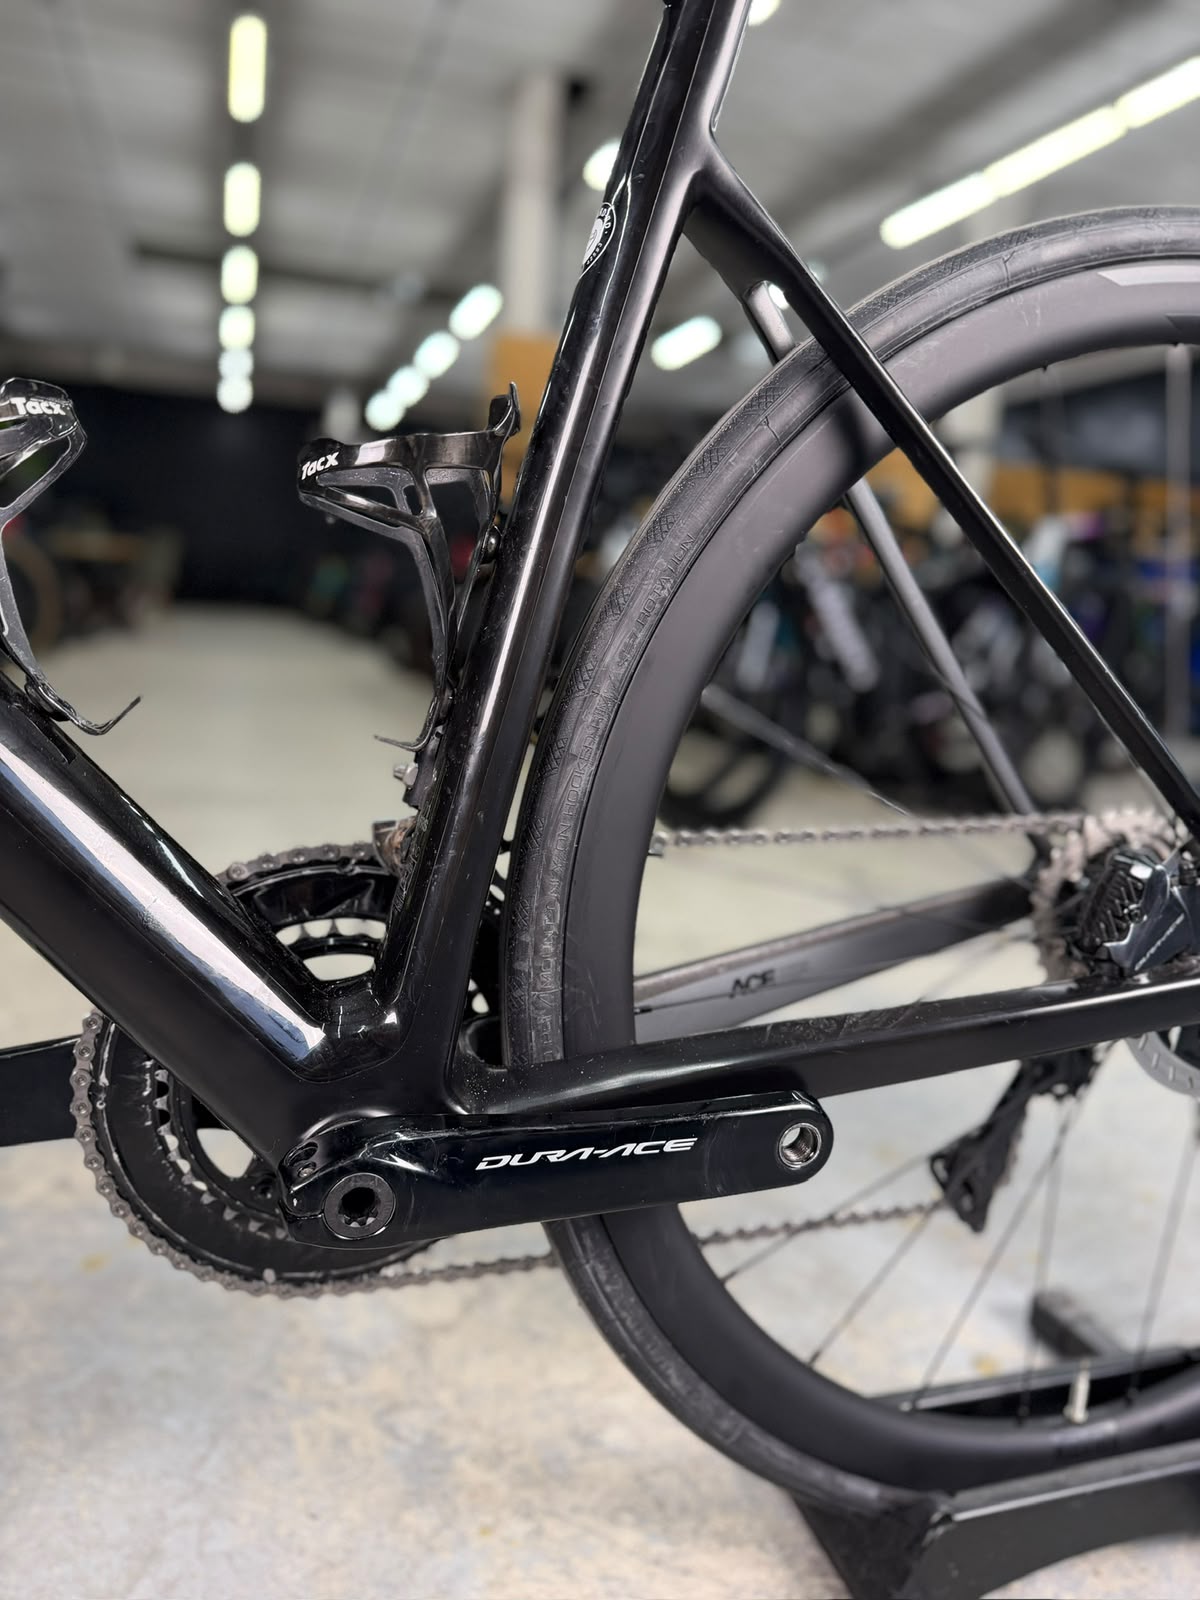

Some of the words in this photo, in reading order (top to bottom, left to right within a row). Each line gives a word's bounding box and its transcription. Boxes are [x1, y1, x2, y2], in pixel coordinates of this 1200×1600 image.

[9, 396, 66, 416] Tacx
[301, 451, 339, 480] Tacx
[475, 1137, 698, 1171] DURA-ACE
